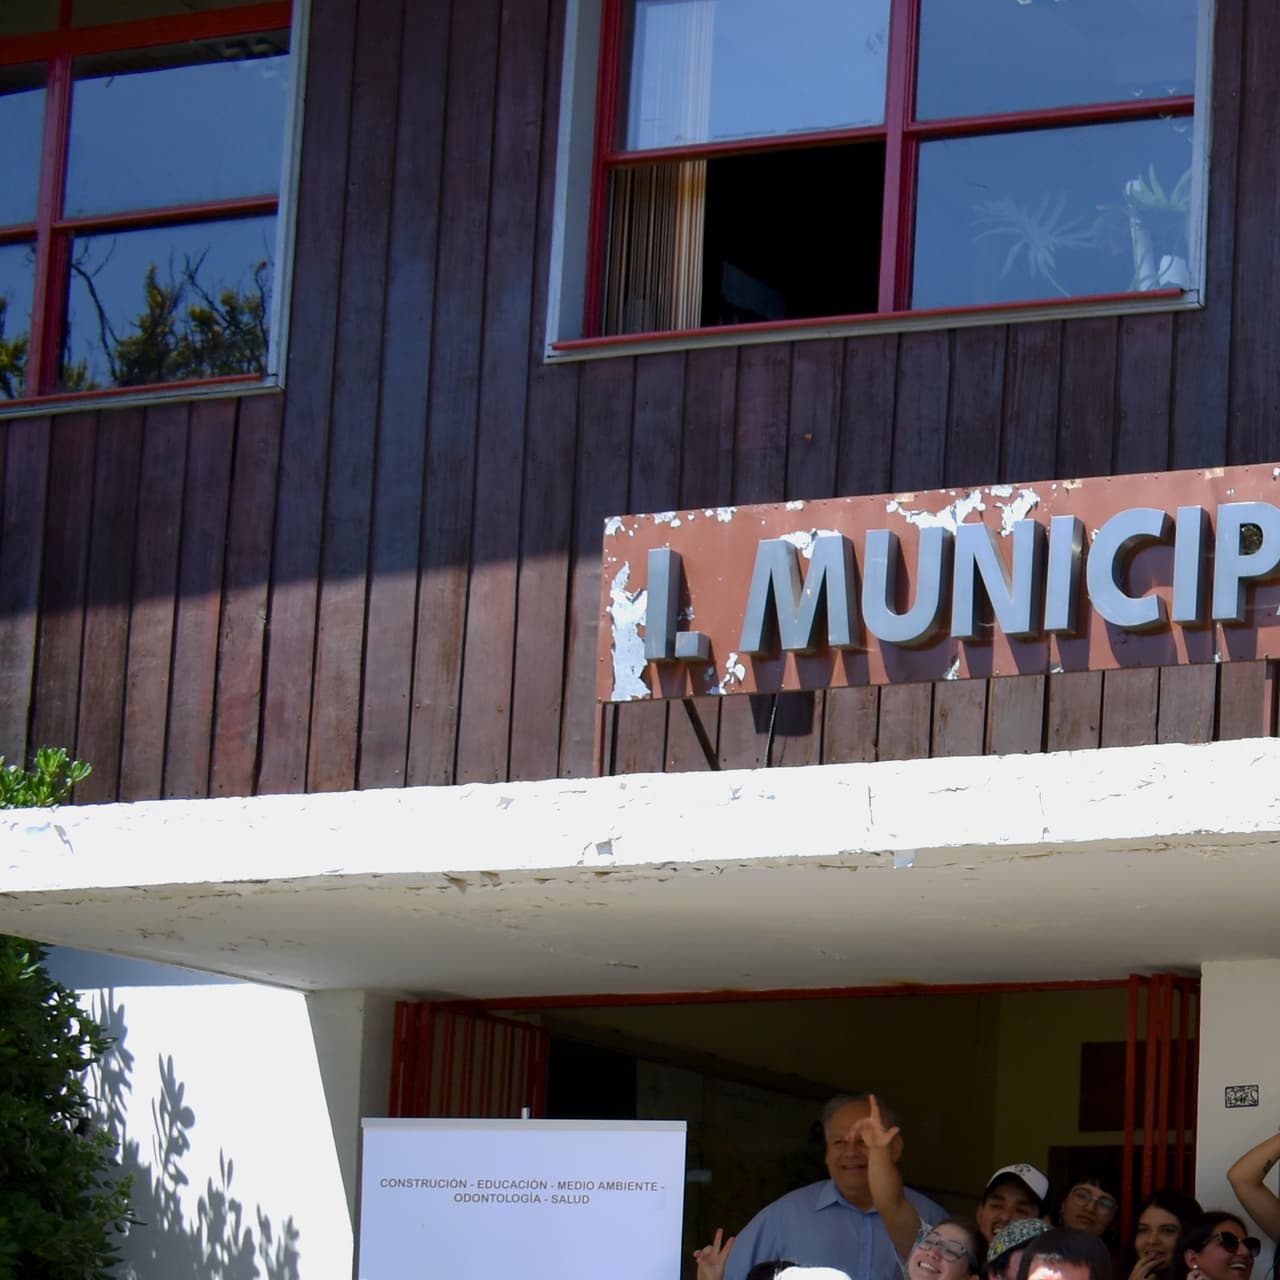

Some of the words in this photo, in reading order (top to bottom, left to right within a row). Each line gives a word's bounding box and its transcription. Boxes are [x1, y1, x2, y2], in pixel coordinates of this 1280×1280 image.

[645, 547, 709, 664] I.
[477, 1179, 547, 1190] EDUCACIÓN
[557, 1181, 595, 1191] MEDIO
[598, 1181, 657, 1191] AMBIENTE
[454, 1192, 541, 1204] ODONTOLOGÍA
[551, 1194, 590, 1205] SALUD
